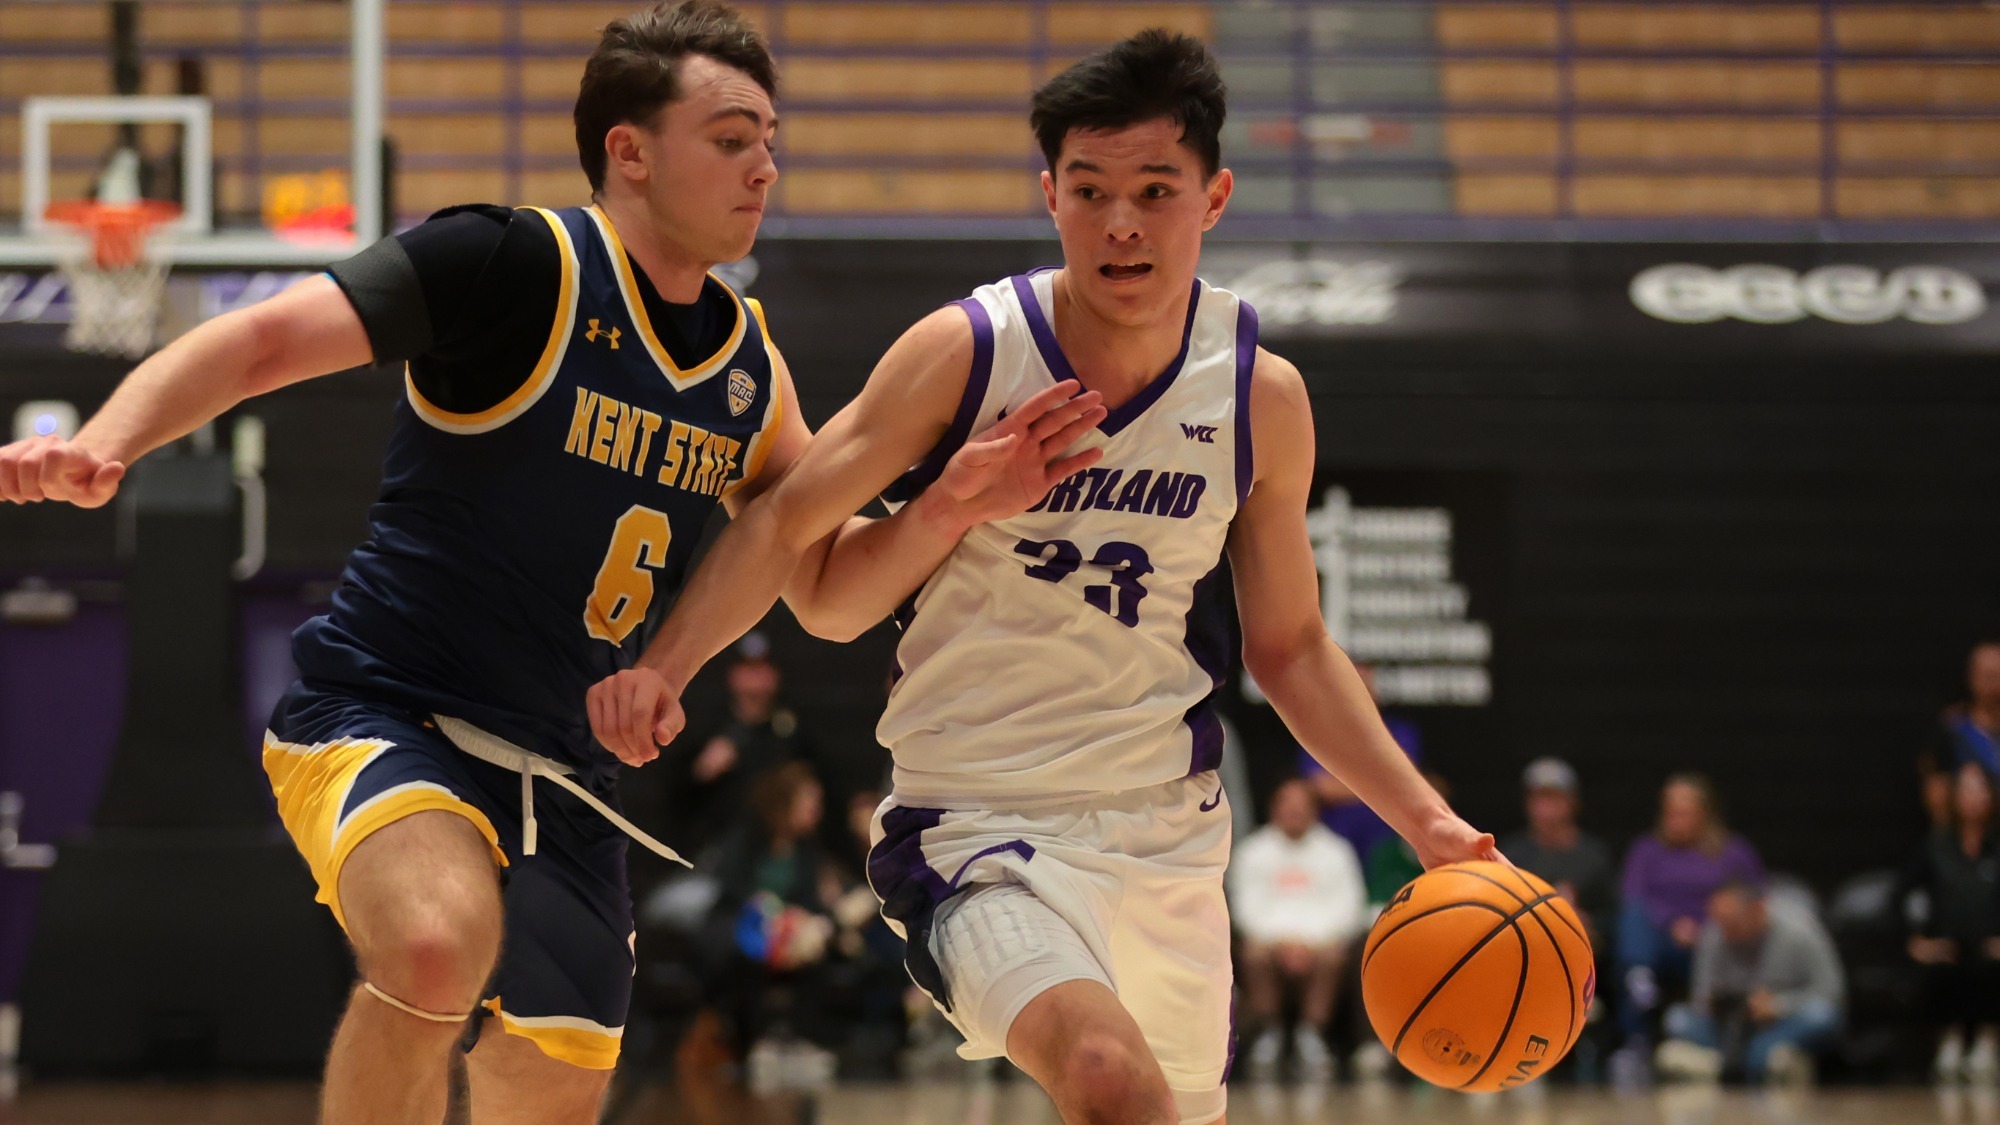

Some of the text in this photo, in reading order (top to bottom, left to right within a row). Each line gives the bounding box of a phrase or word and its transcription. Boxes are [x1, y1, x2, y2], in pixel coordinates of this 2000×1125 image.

[730, 381, 753, 402] MAC
[564, 386, 742, 497] KENT STATE
[1179, 422, 1219, 444] WCC
[1024, 467, 1207, 519] RTLAND
[583, 503, 672, 648] 6
[1013, 538, 1155, 628] 23
